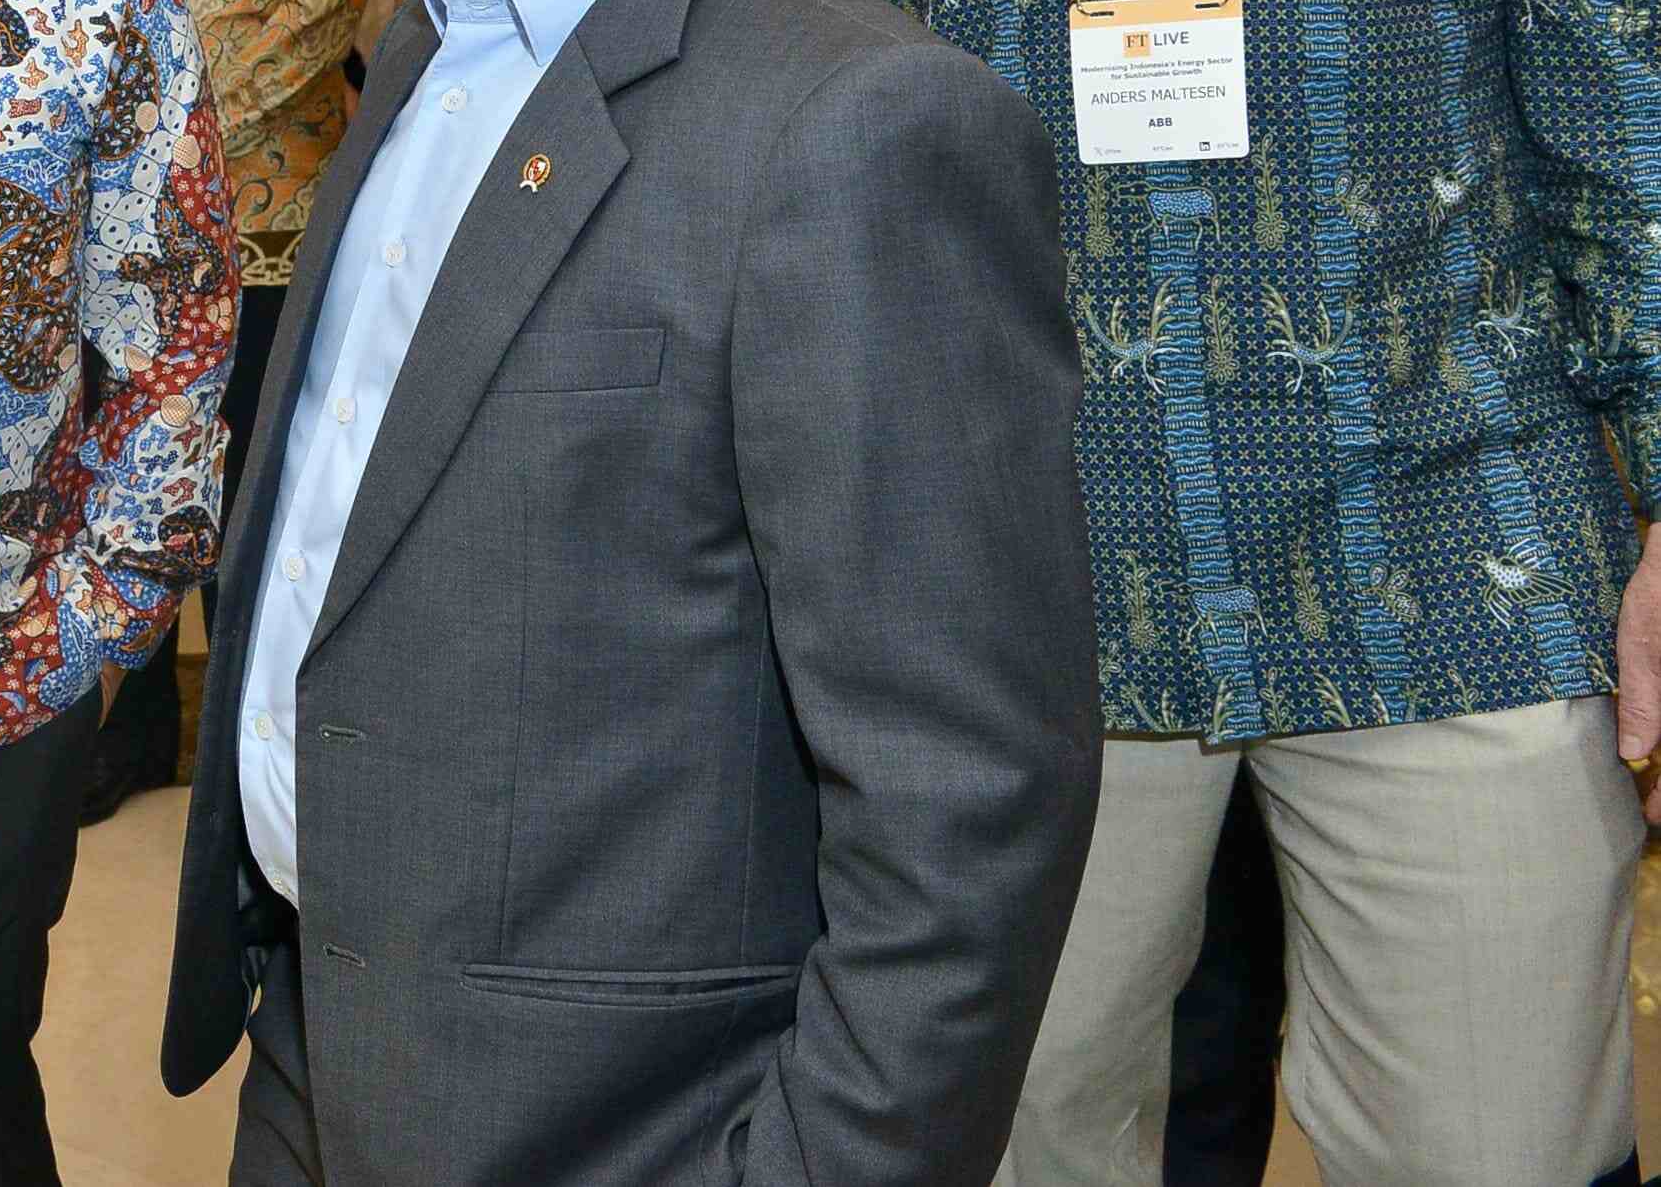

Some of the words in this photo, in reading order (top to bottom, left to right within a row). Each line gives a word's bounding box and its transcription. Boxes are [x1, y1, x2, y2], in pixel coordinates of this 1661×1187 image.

[1126, 33, 1149, 48] FT
[1153, 31, 1189, 47] LIVE
[1177, 59, 1205, 67] Energy
[1207, 56, 1233, 64] Sector
[1124, 70, 1170, 79] Sustainable
[1172, 68, 1203, 76] Growth
[1091, 89, 1147, 106] ANDERS
[1151, 85, 1227, 102] MALTESEN
[1148, 117, 1173, 128] ABB
